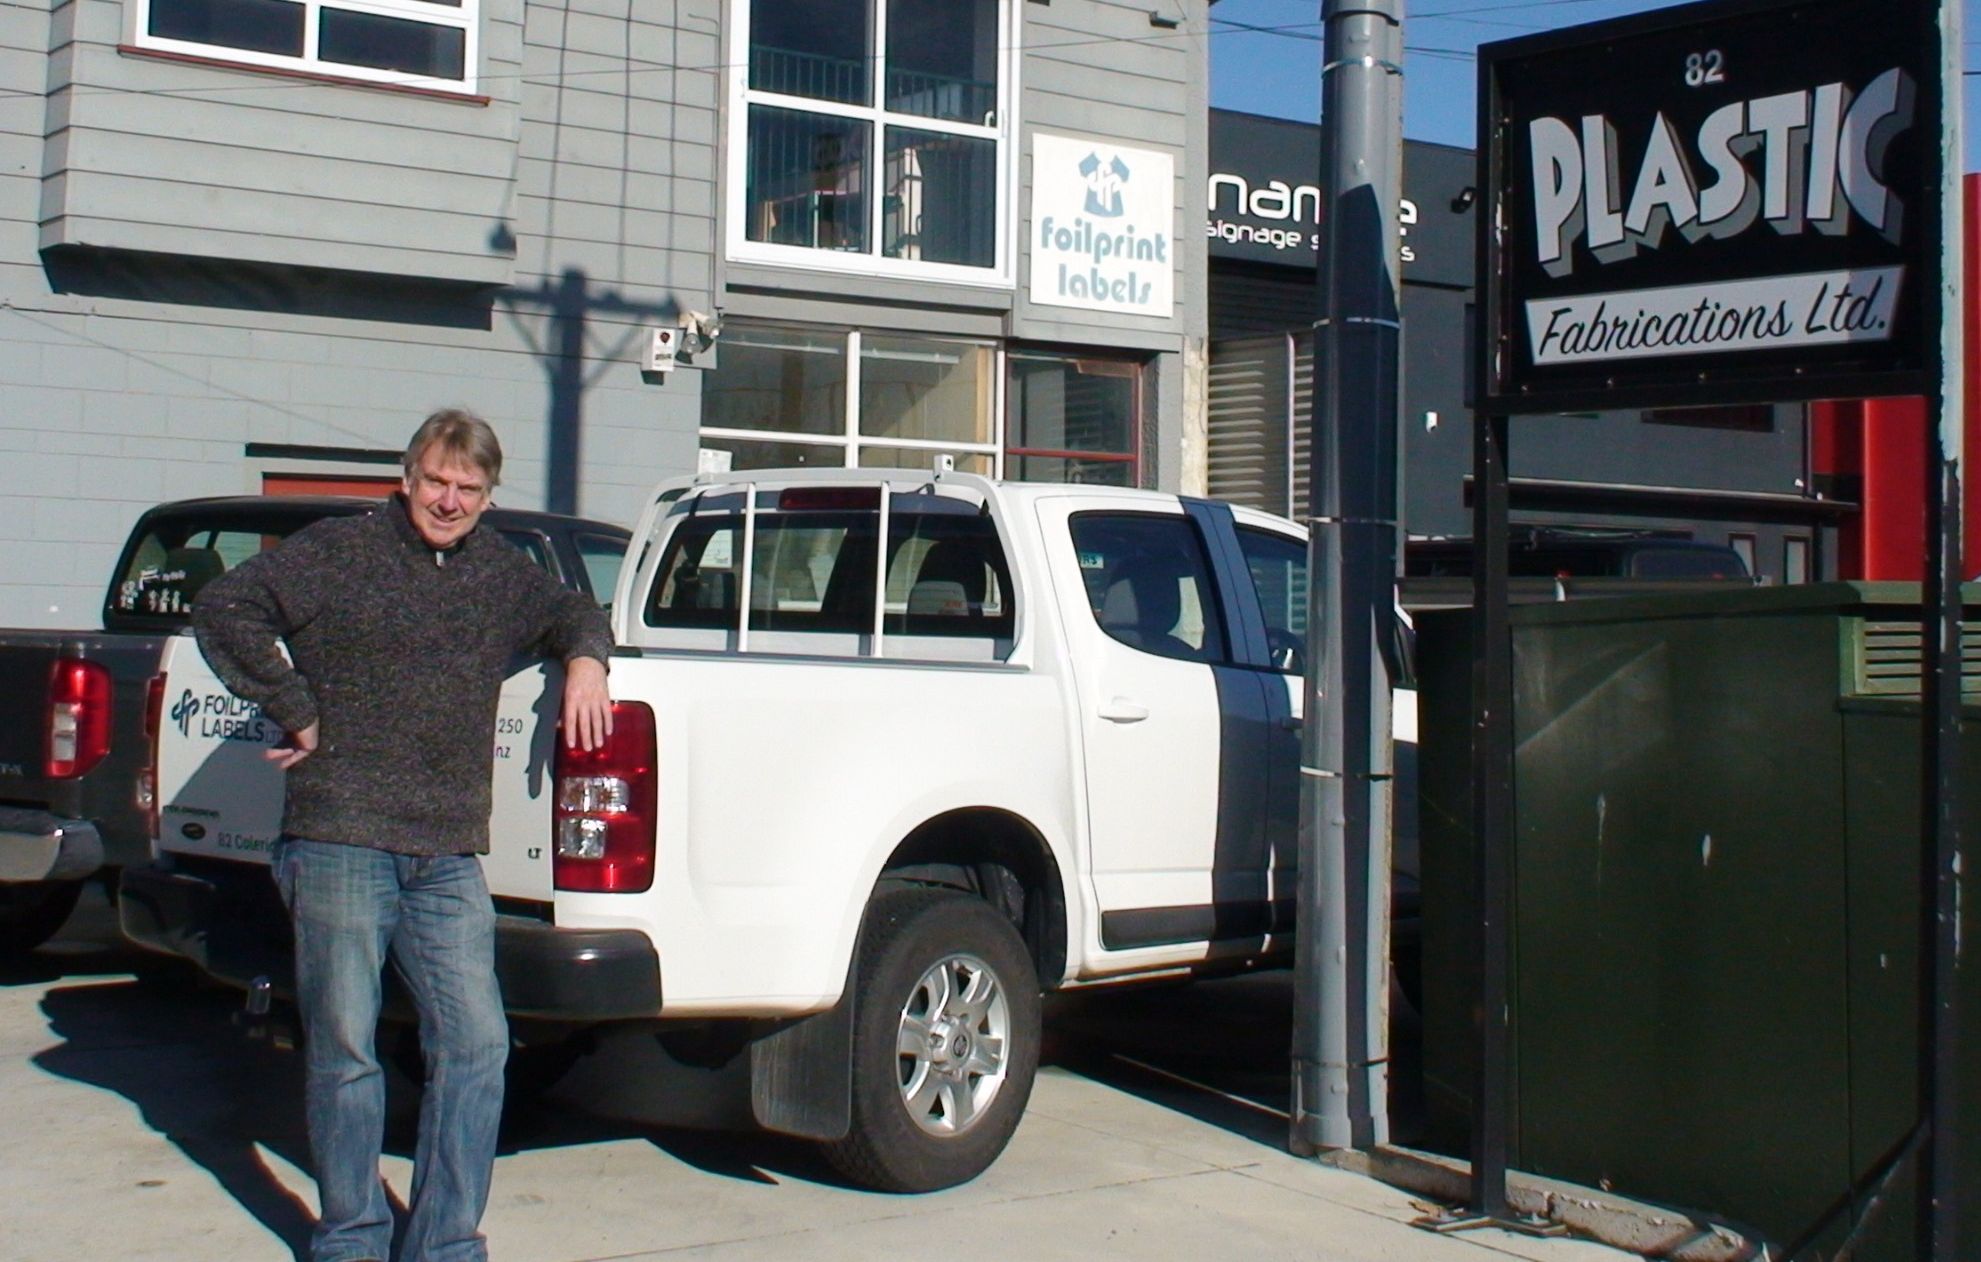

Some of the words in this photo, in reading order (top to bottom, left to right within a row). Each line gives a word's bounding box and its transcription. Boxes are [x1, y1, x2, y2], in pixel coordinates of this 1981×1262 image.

[1684, 50, 1725, 87] 82
[1530, 67, 1914, 276] PLASTIC
[1040, 216, 1167, 264] foilprint
[1207, 219, 1302, 250] signage
[1058, 264, 1152, 305] labels
[1540, 300, 1793, 357] Fabrications
[1805, 275, 1887, 335] Ltd.
[203, 695, 262, 717] FOILPR
[202, 717, 265, 742] LABELS
[498, 719, 523, 734] 250
[217, 831, 232, 848] 82
[235, 833, 274, 853] Coleri
